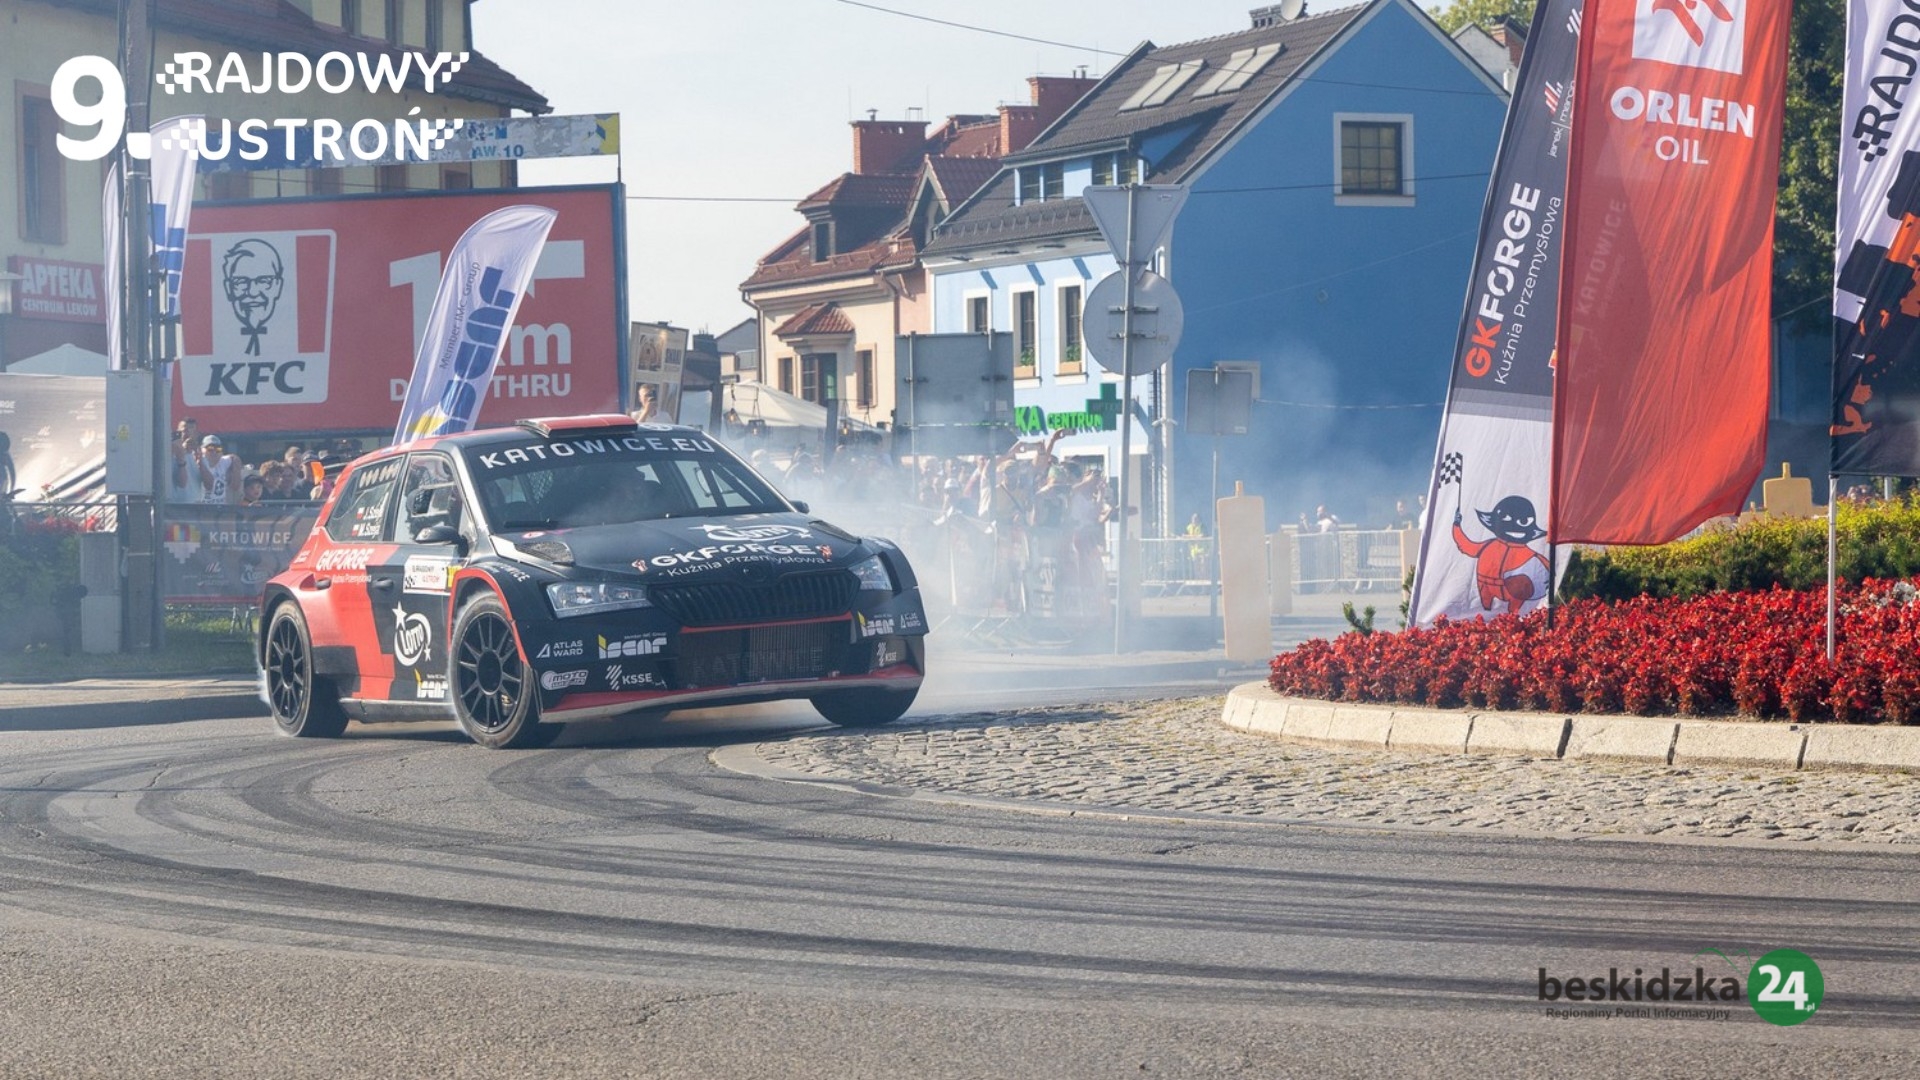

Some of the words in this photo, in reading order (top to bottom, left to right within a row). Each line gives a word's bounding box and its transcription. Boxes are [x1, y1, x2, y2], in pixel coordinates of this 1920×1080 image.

[1852, 0, 1920, 139] RAJD
[1610, 86, 1755, 138] ORLEN
[1655, 135, 1709, 165] OIL
[20, 262, 96, 299] APTEKA
[1465, 182, 1541, 377] GKFORGE
[1494, 323, 1523, 384] Kuźnia
[1514, 195, 1562, 318] Przemysłowa
[22, 299, 65, 314] CENTRUM
[439, 323, 462, 370] Member
[463, 261, 481, 296] Group
[204, 360, 306, 396] KFC
[493, 373, 571, 398] THRU
[1047, 411, 1103, 431] CENTRUM
[479, 438, 715, 469] KATOWICE.EU
[210, 531, 293, 544] KATOWICE
[316, 548, 375, 571] GKFORGE
[651, 542, 818, 567] GKFORGE
[667, 561, 722, 578] Kuźnia
[553, 640, 584, 650] ATLAS
[553, 648, 584, 657] WARD
[552, 671, 587, 682] MOTO
[622, 673, 653, 685] KSSE
